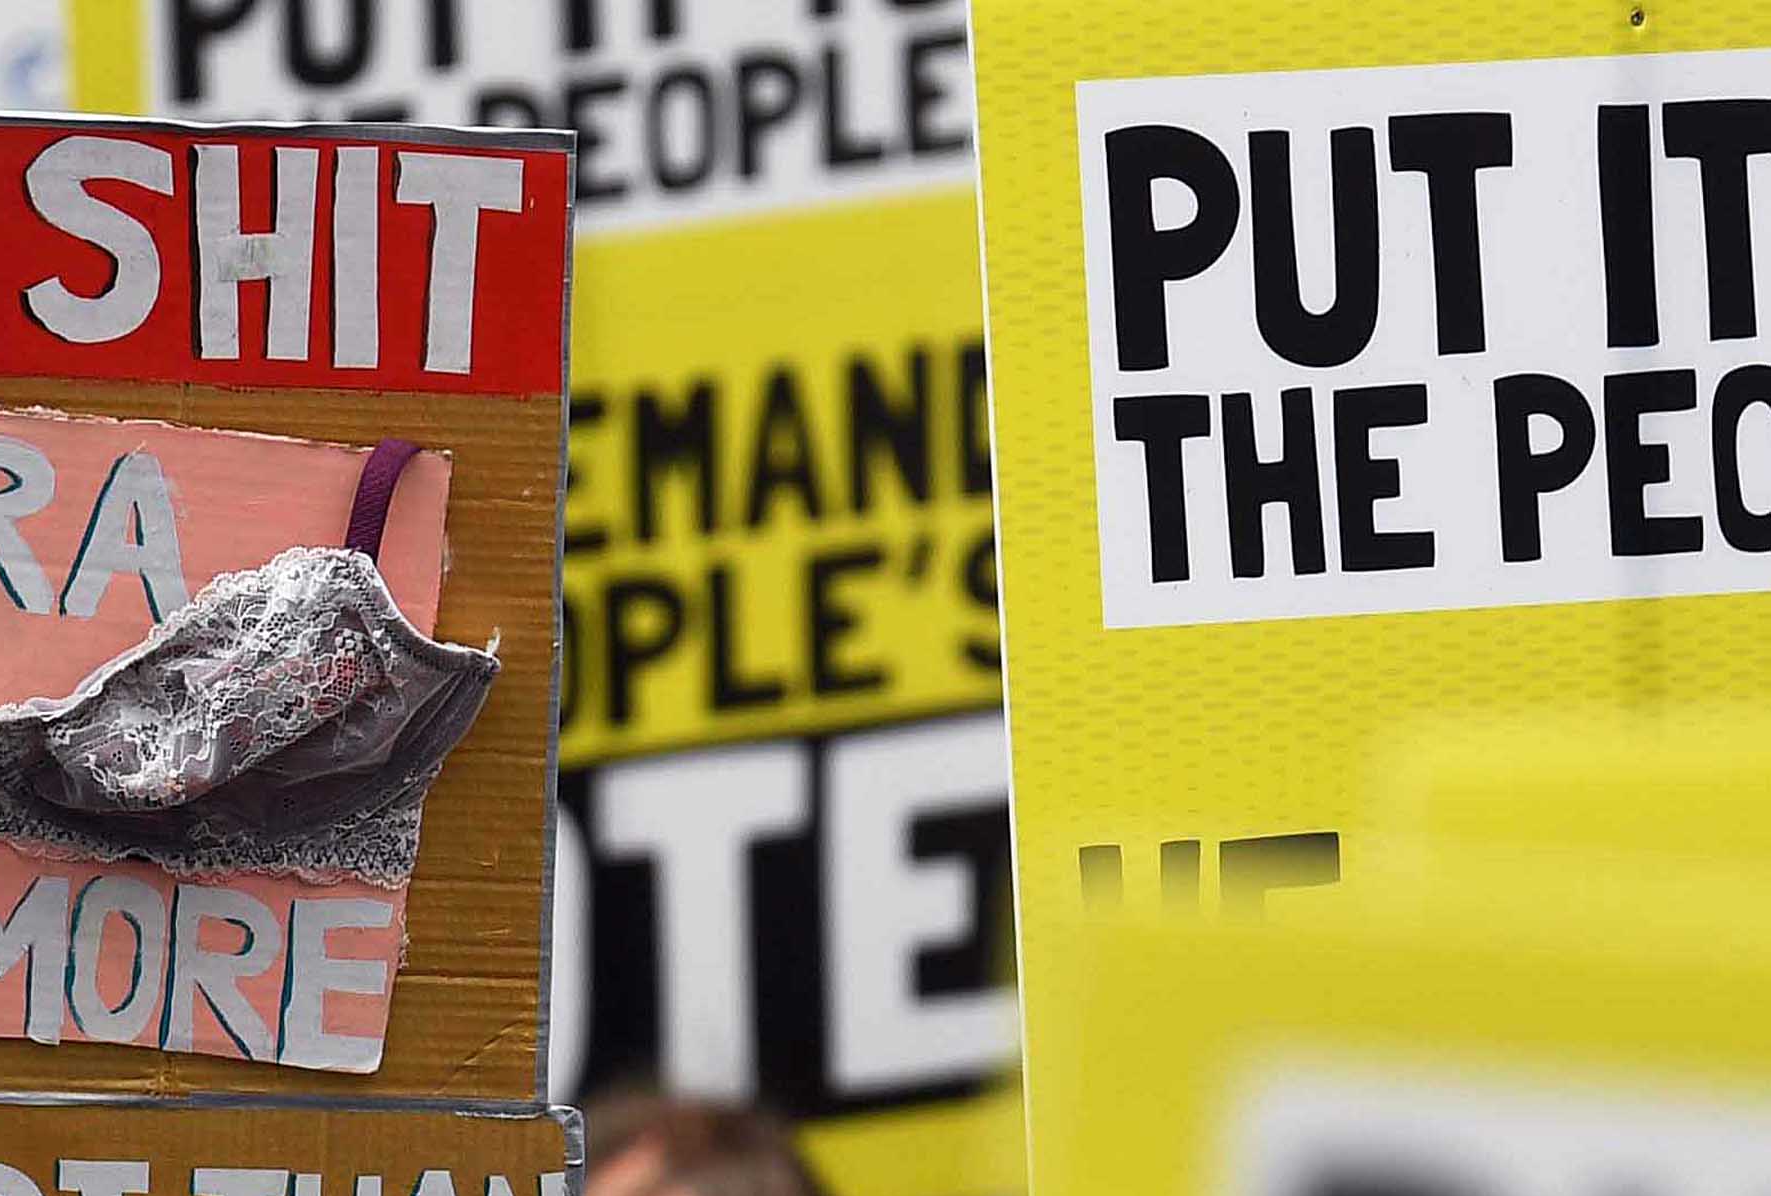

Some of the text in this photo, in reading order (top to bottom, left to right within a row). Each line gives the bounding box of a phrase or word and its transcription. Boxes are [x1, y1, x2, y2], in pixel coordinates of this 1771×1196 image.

[20, 135, 524, 375] SHIT
[1104, 98, 1771, 373] PUT IT
[1113, 383, 1436, 584] THE
[560, 530, 1000, 730] PLE'S
[548, 712, 1021, 1105] TE
